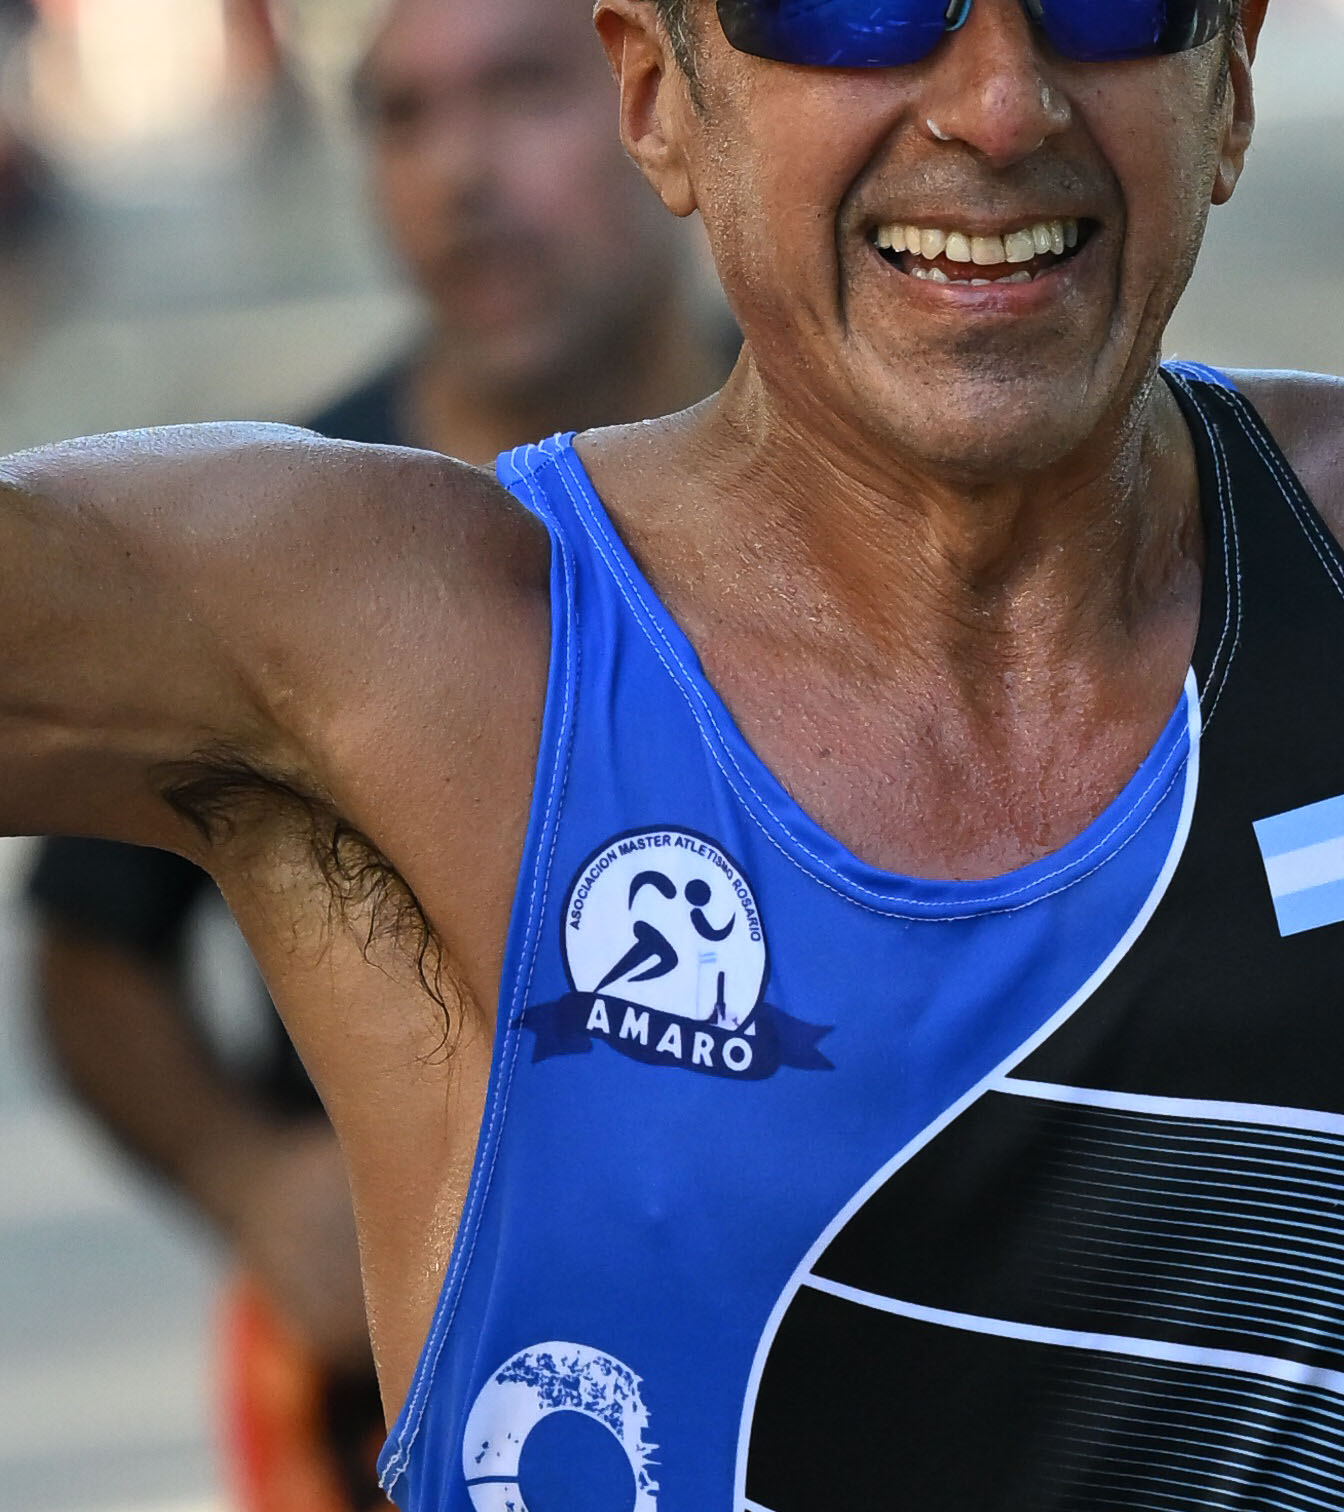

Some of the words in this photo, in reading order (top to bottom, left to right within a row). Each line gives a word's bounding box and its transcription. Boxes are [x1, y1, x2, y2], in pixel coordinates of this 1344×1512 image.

[570, 849, 618, 930] ASOCIACION
[618, 834, 671, 856] MASTER
[674, 836, 733, 880] ATLETISMO
[732, 878, 761, 942] ROSARIO
[586, 998, 753, 1072] AMARO
